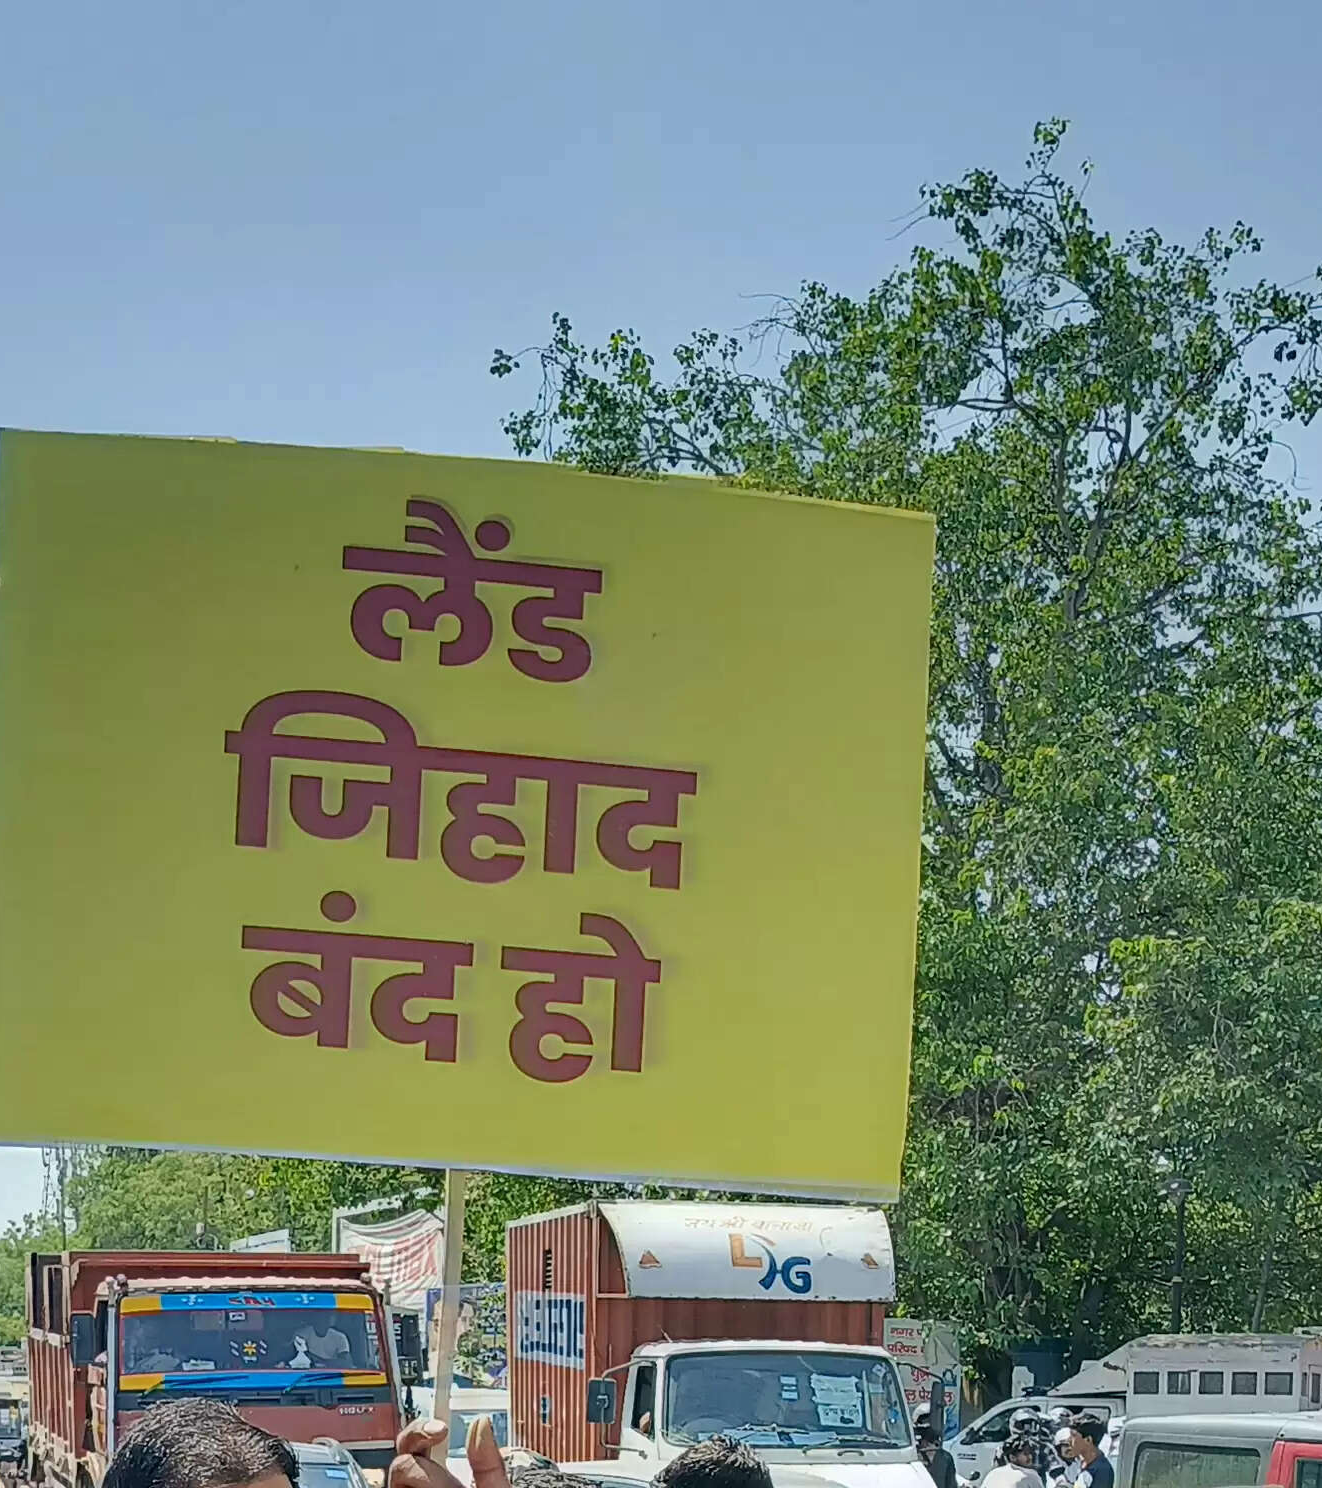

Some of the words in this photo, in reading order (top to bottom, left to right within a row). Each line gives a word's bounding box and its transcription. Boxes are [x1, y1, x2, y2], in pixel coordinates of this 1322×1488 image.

[342, 497, 603, 683] लैंड
[224, 690, 698, 890] जिहाद
[241, 890, 474, 1063] बंद
[500, 912, 661, 1083] हो
